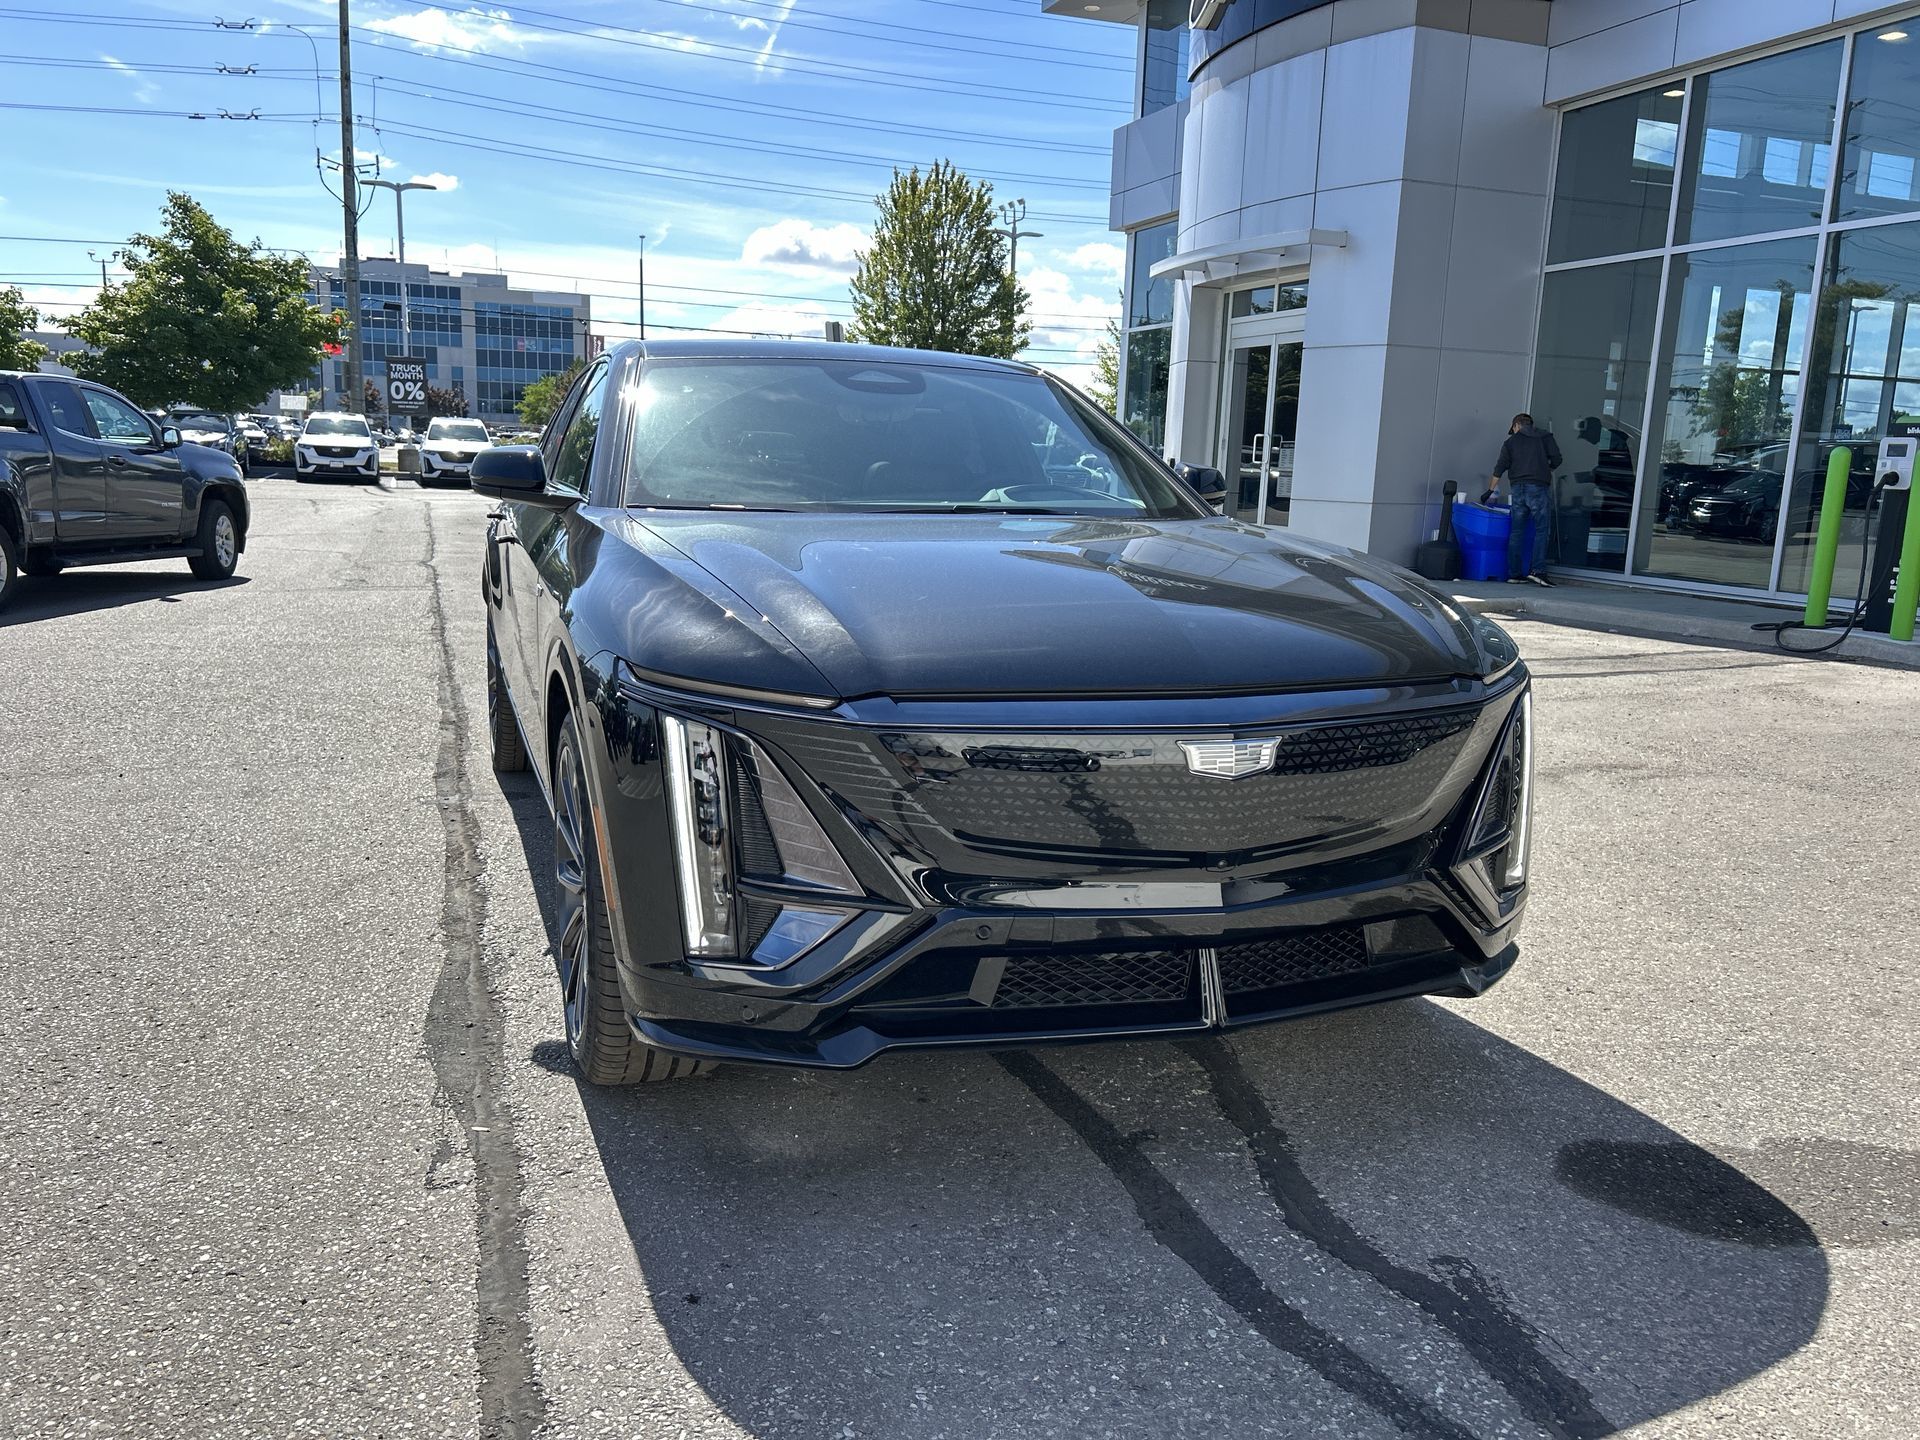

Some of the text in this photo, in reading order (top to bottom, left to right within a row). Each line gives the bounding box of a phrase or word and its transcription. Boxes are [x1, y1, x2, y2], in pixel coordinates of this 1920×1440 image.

[390, 363, 423, 373] TRUCK
[390, 371, 423, 380] MONTH
[390, 381, 425, 400] 0%
